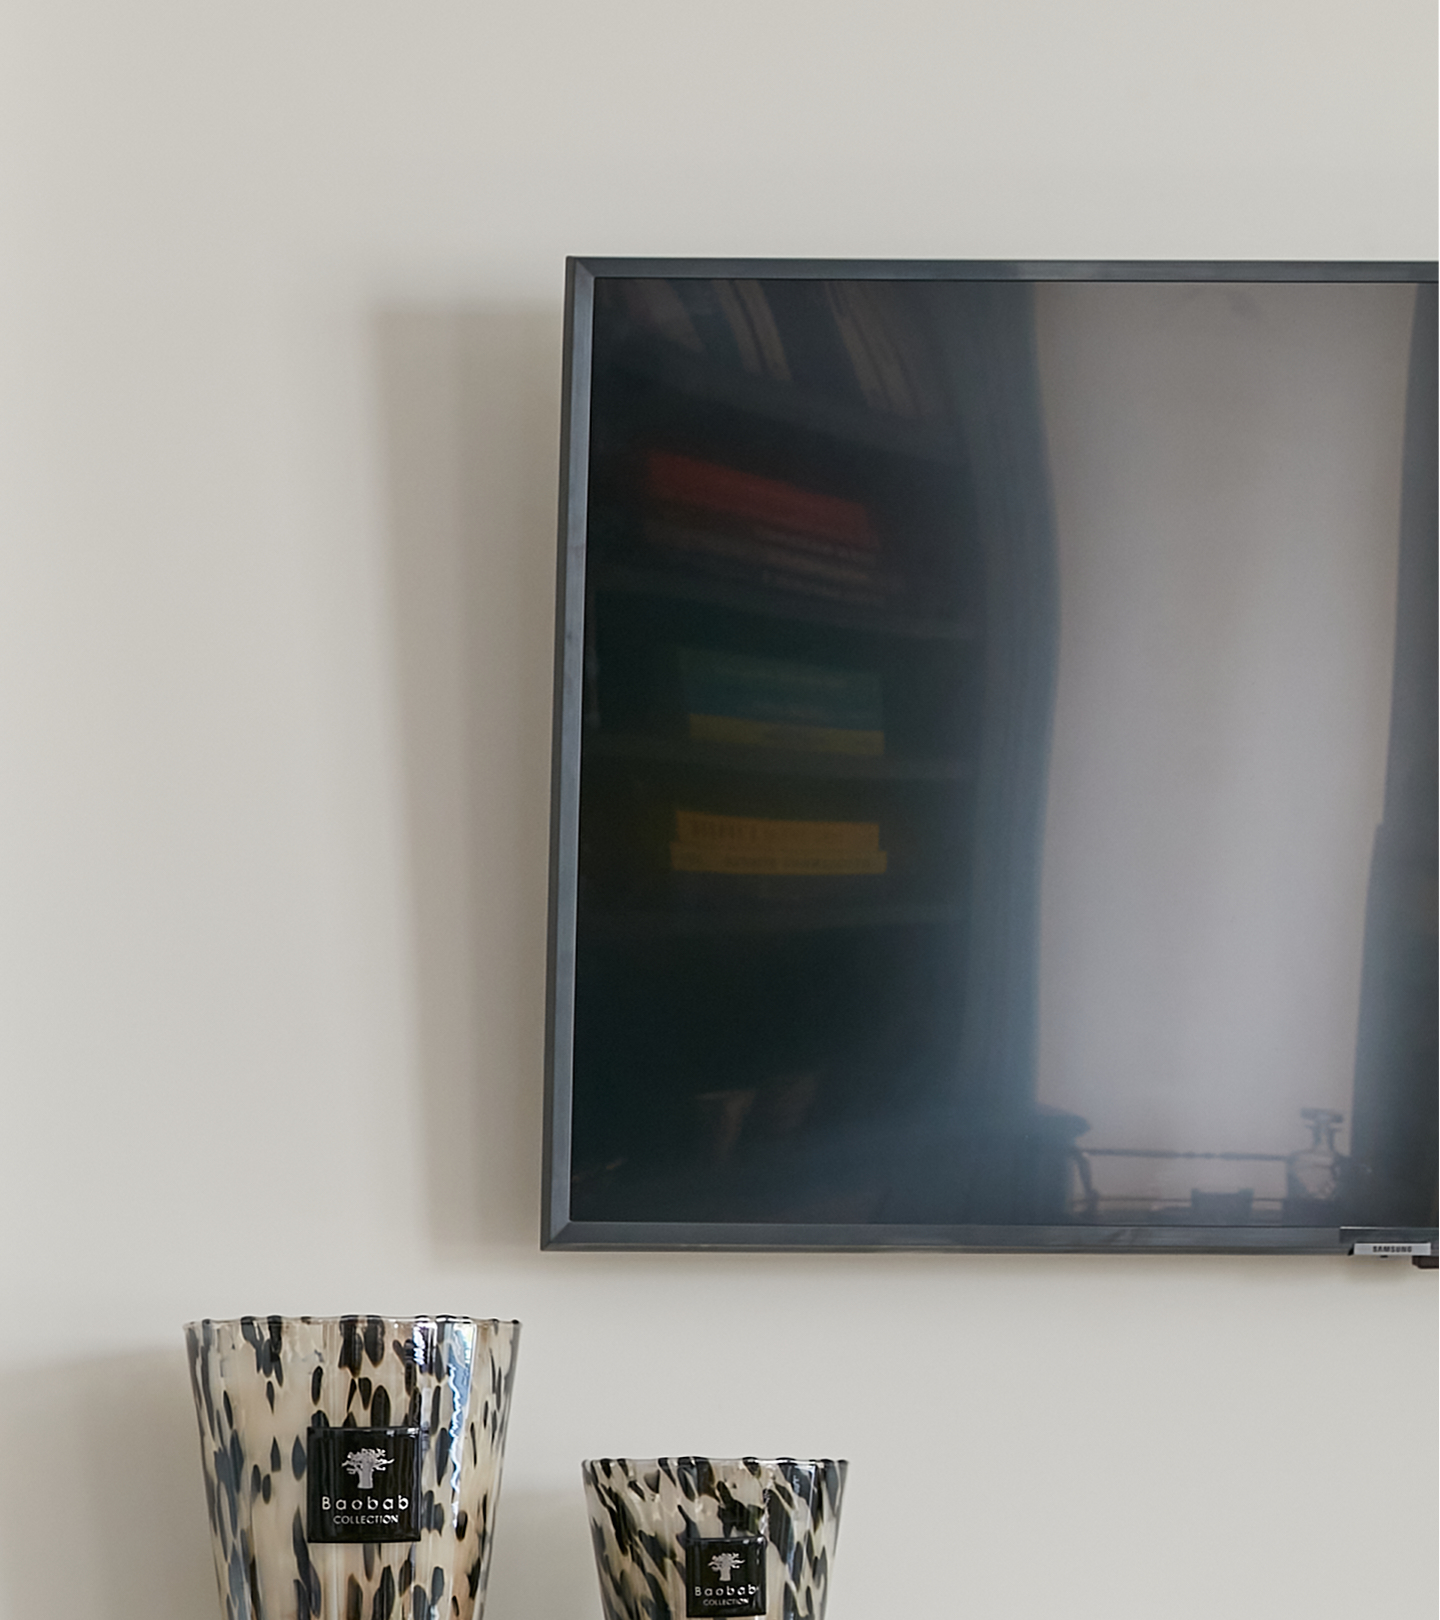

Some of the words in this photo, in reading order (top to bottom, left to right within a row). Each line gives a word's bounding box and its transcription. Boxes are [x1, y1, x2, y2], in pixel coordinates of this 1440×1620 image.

[321, 1495, 409, 1511] Baobab
[333, 1515, 399, 1525] COLLECTION
[694, 1584, 757, 1596] Baobab
[703, 1598, 749, 1606] COLLECTION
